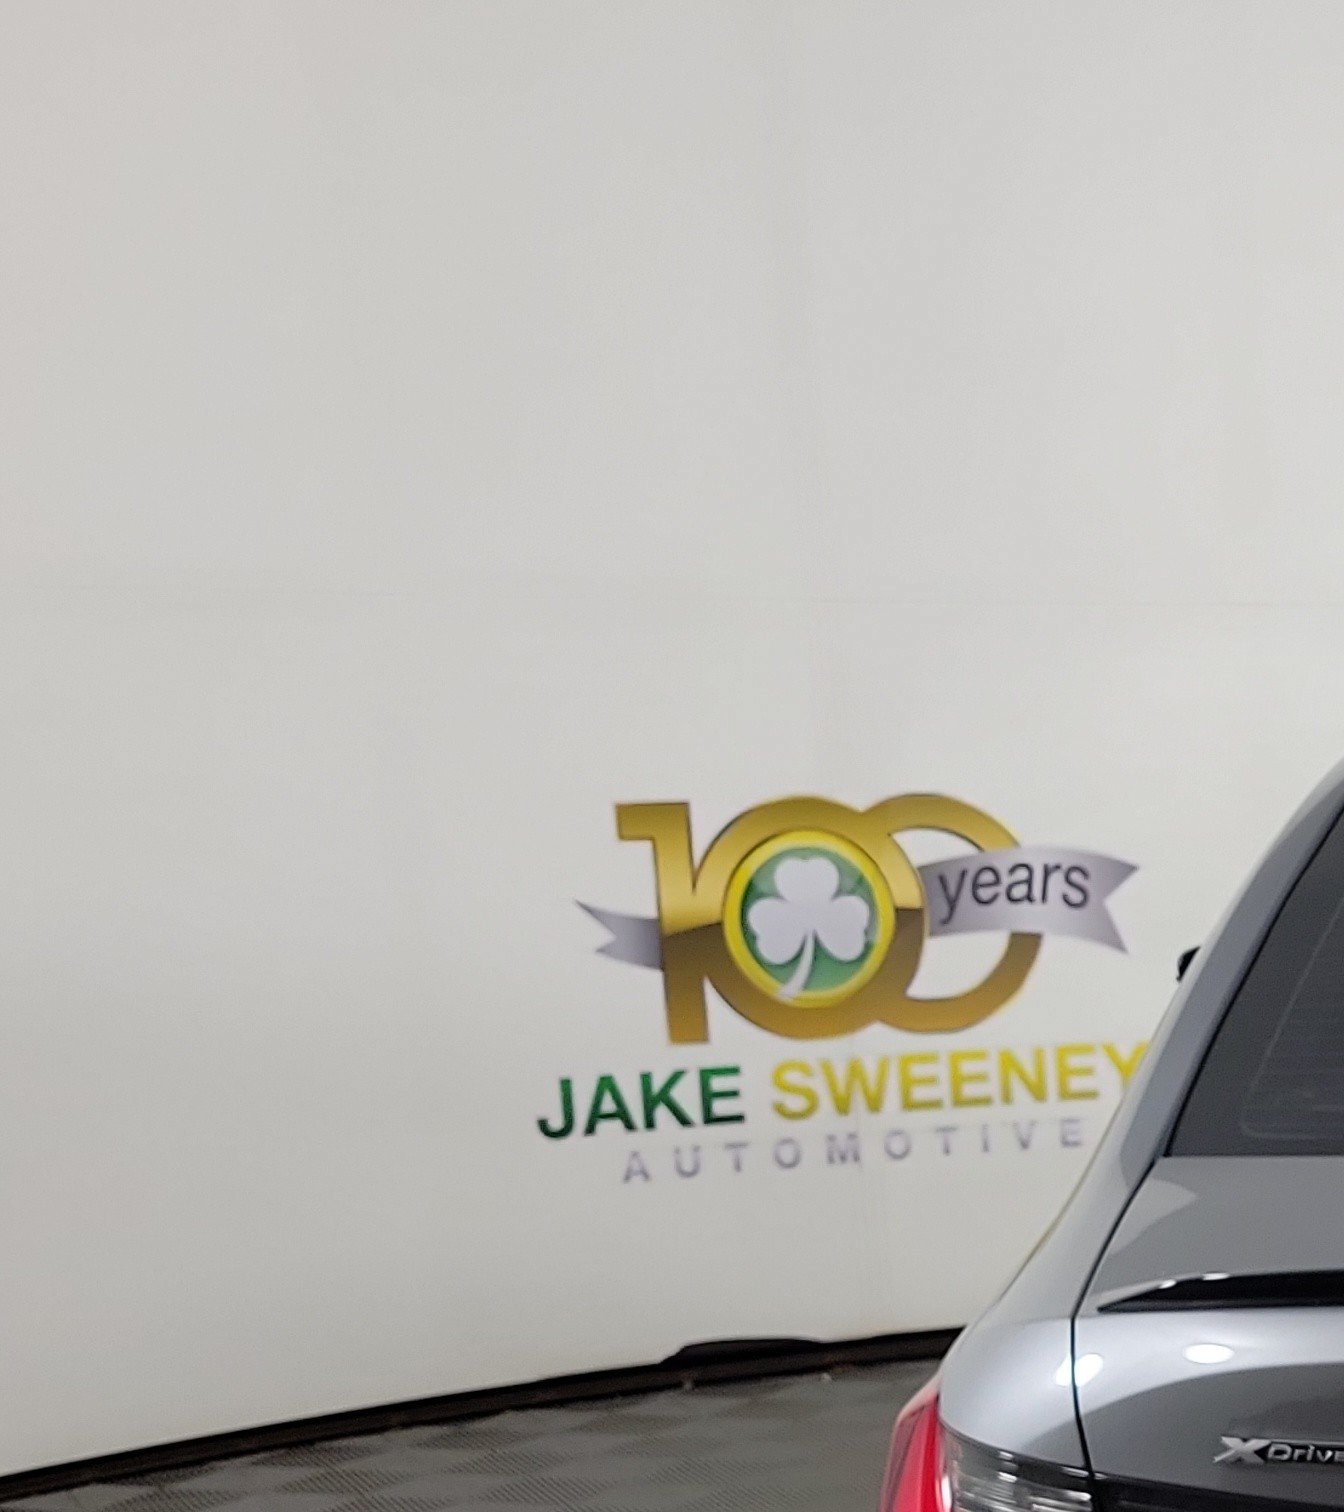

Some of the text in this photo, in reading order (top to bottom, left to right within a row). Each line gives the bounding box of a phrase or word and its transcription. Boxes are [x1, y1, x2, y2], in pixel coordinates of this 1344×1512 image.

[614, 793, 1090, 1045] 100 years
[537, 1042, 1148, 1139] JAKE SWEENEY
[621, 1116, 1087, 1184] AUTOMOTIVE
